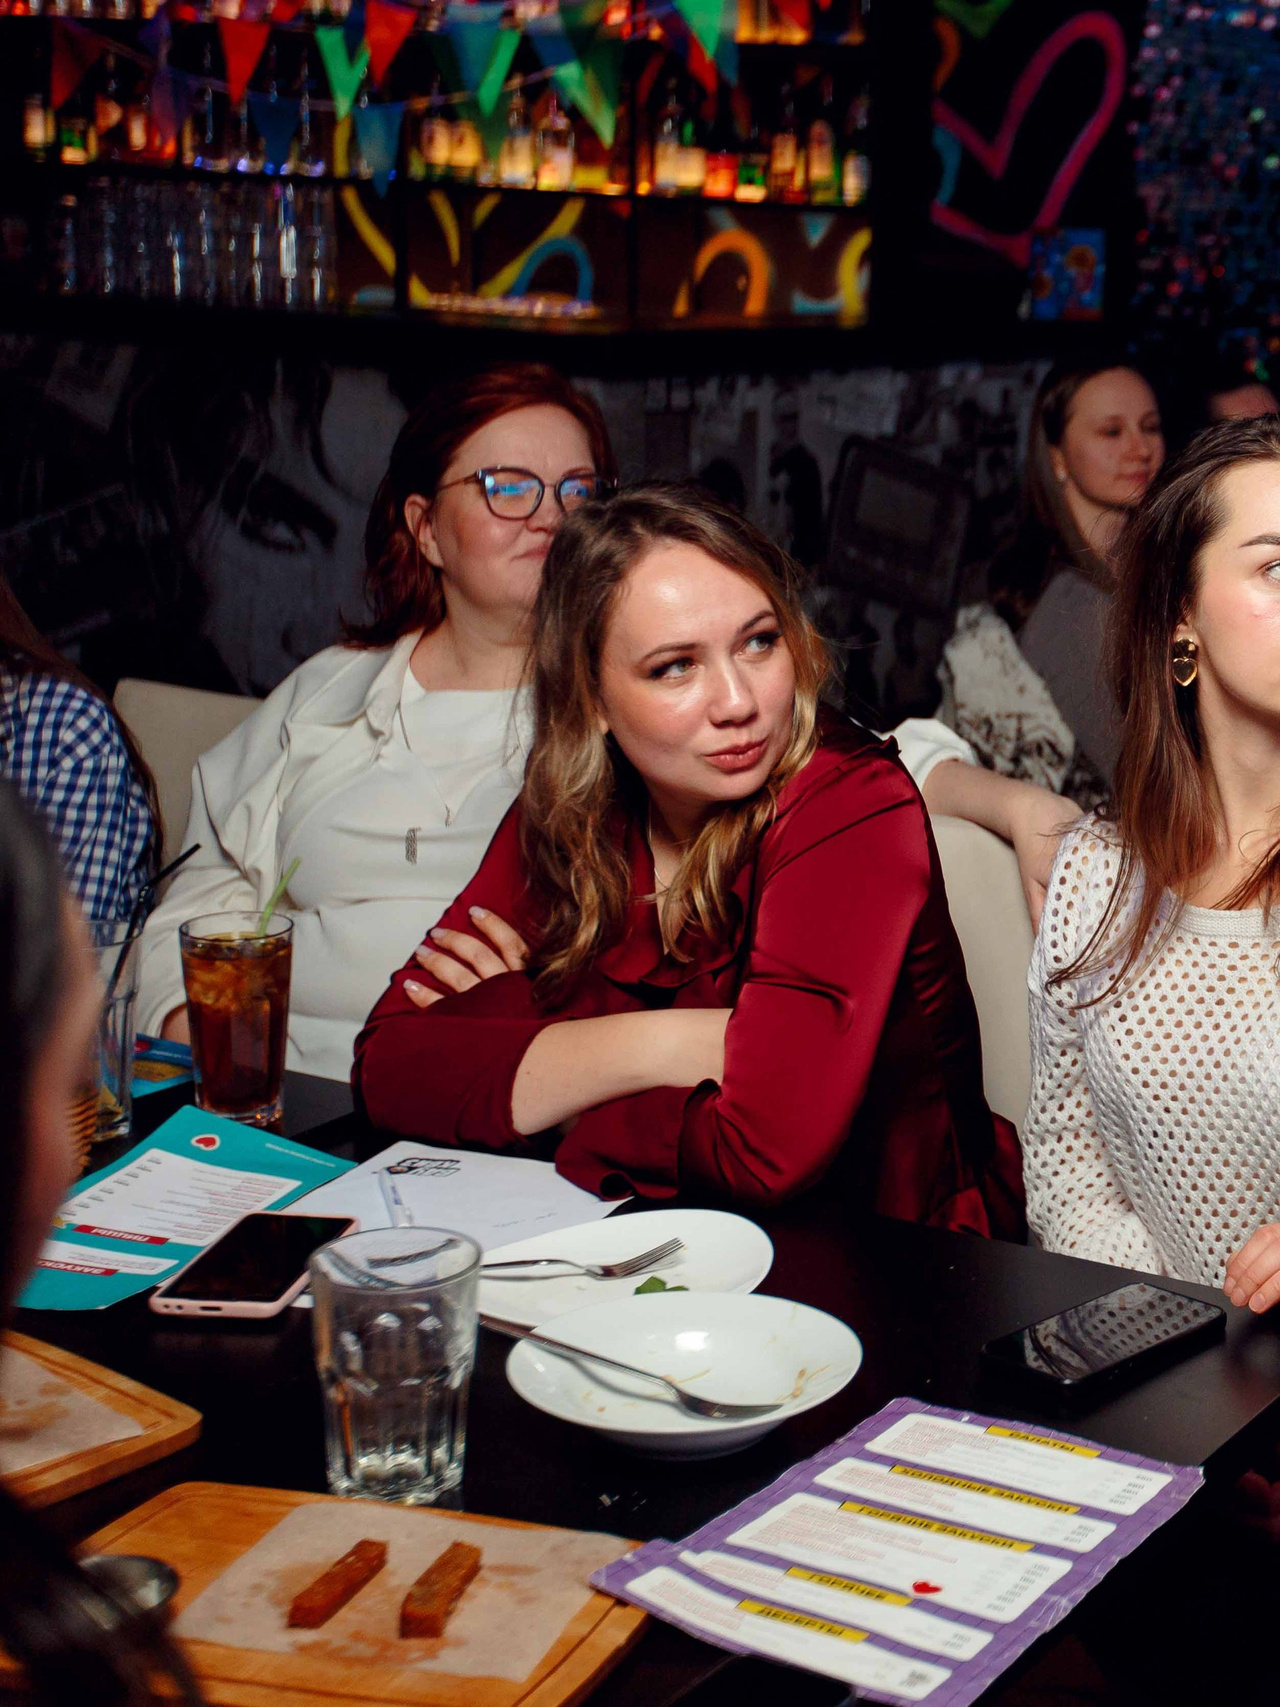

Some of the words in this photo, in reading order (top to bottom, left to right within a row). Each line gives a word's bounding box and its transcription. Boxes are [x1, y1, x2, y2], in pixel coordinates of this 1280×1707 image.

[90, 1228, 150, 1243] ПИЦЦЫ
[1009, 1431, 1075, 1452] САЛАТЫ
[900, 1467, 987, 1493] ХОЛОДНЫЕ
[993, 1488, 1071, 1513] ЗАКУСКИ
[858, 1506, 932, 1529] ГОРЯЧИЕ
[935, 1524, 1014, 1549] ЗАКУСКИ
[809, 1573, 887, 1599] ГОРЯЧЕЕ
[758, 1606, 845, 1636] ДЕСЕРТЫ
